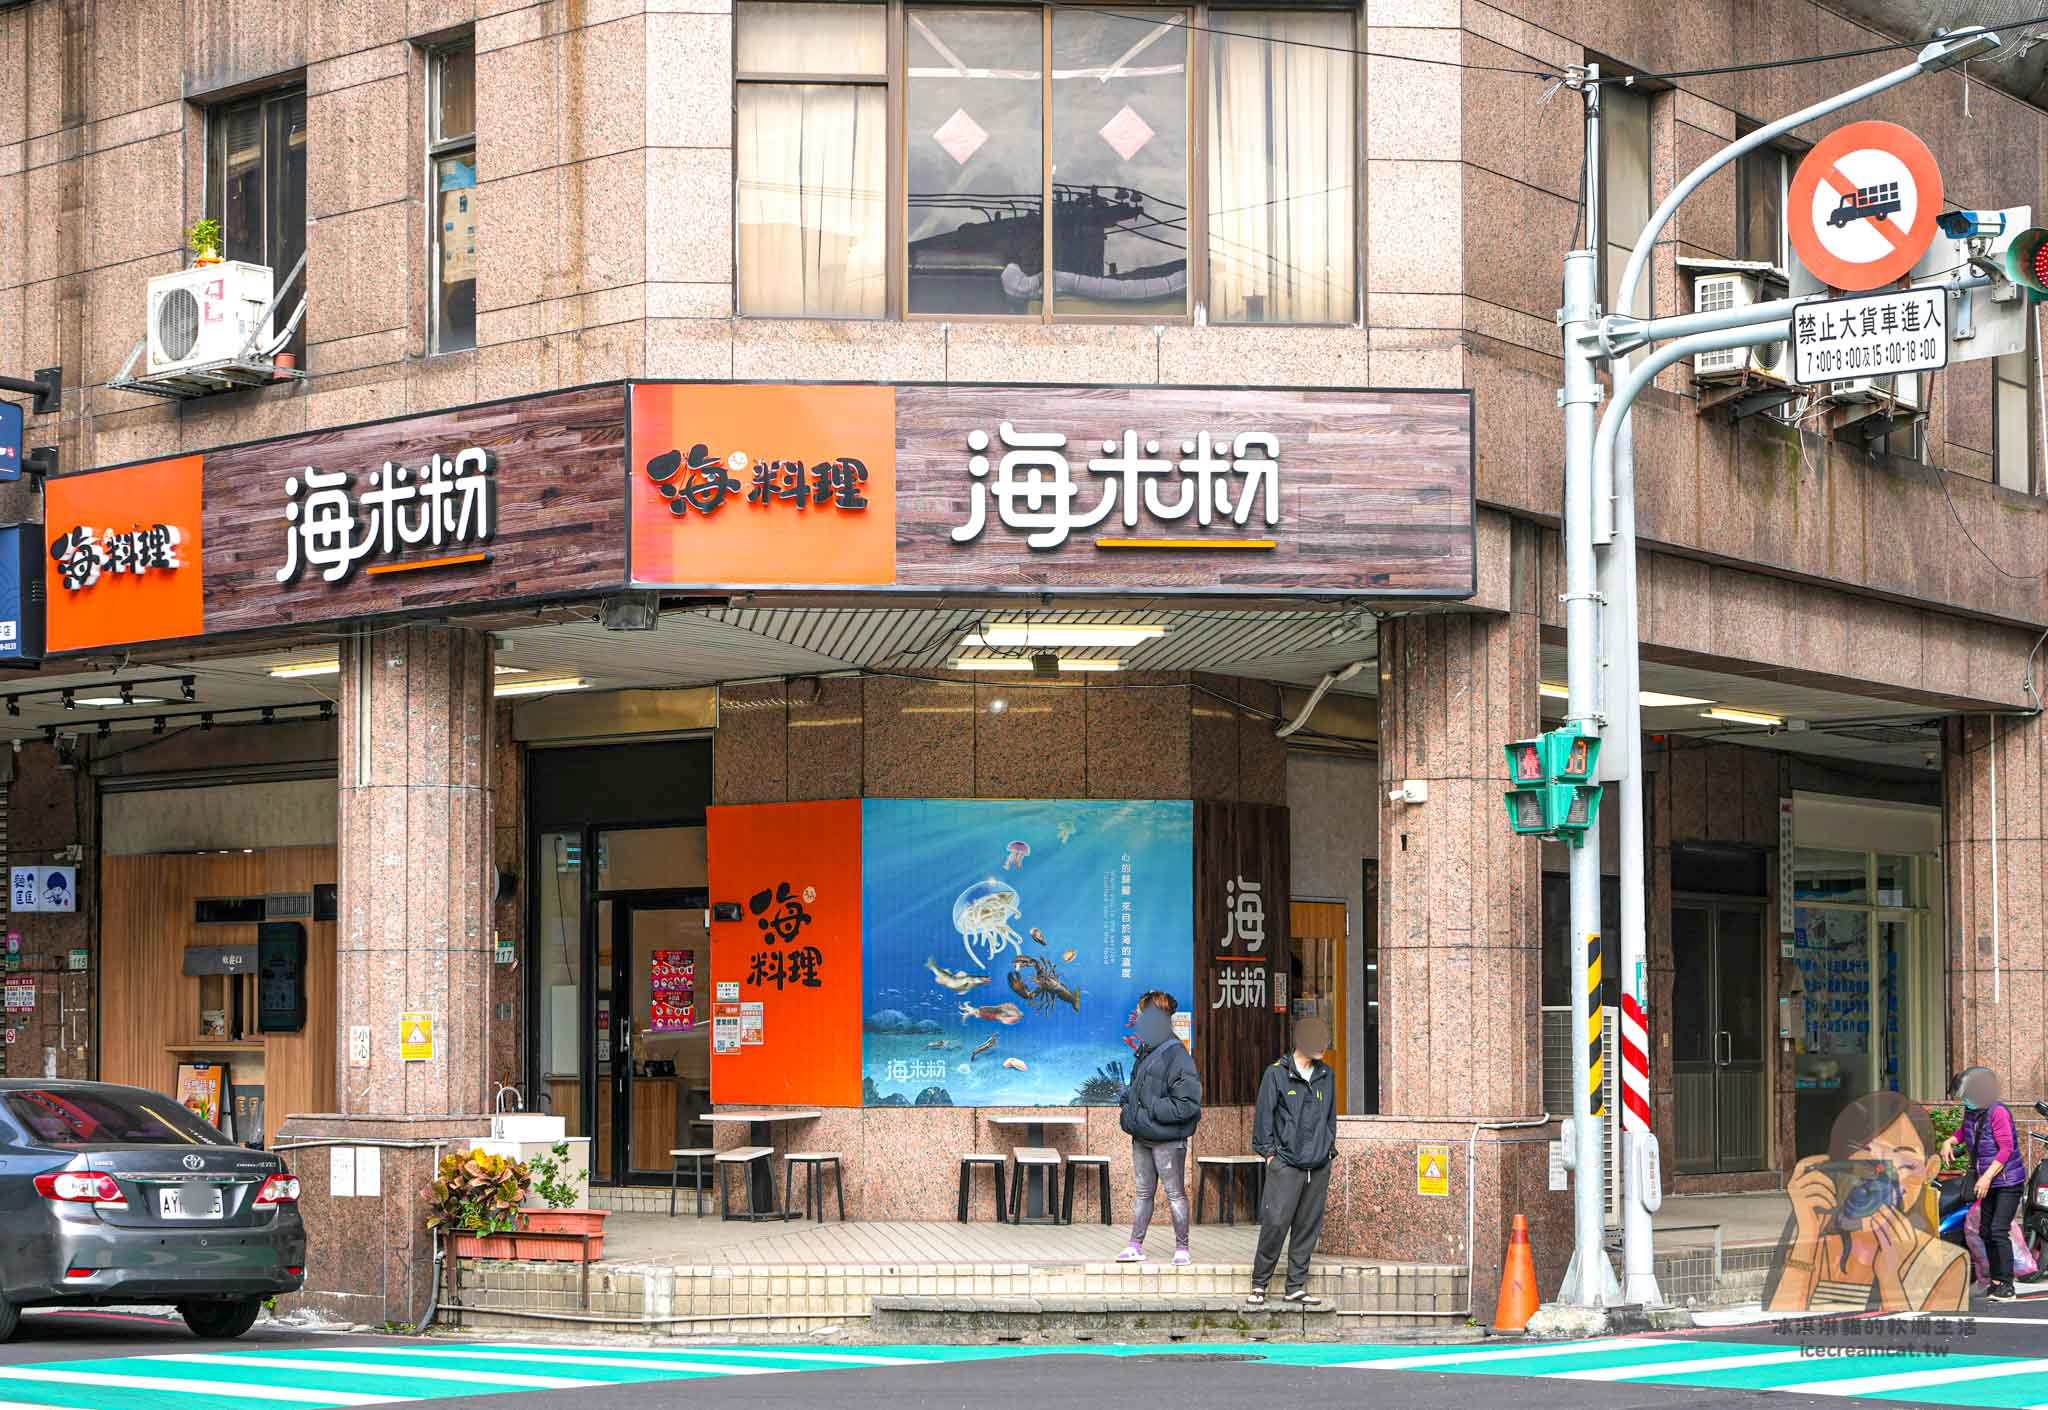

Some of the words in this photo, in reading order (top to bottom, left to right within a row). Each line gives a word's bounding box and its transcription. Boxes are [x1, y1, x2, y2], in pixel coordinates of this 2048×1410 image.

[1799, 299, 1941, 345] 禁止大貨車進入
[646, 443, 869, 516] 海料理
[951, 420, 1280, 548] 海米粉
[275, 447, 490, 583] 海米粉
[50, 524, 175, 592] 海料理
[749, 882, 813, 944] 海
[1220, 875, 1265, 952] 海
[496, 950, 513, 962] 117
[747, 946, 823, 991] 料理
[1212, 966, 1265, 1009] 米粉
[358, 1031, 369, 1059] 小心
[886, 1058, 946, 1083] 海米粉
